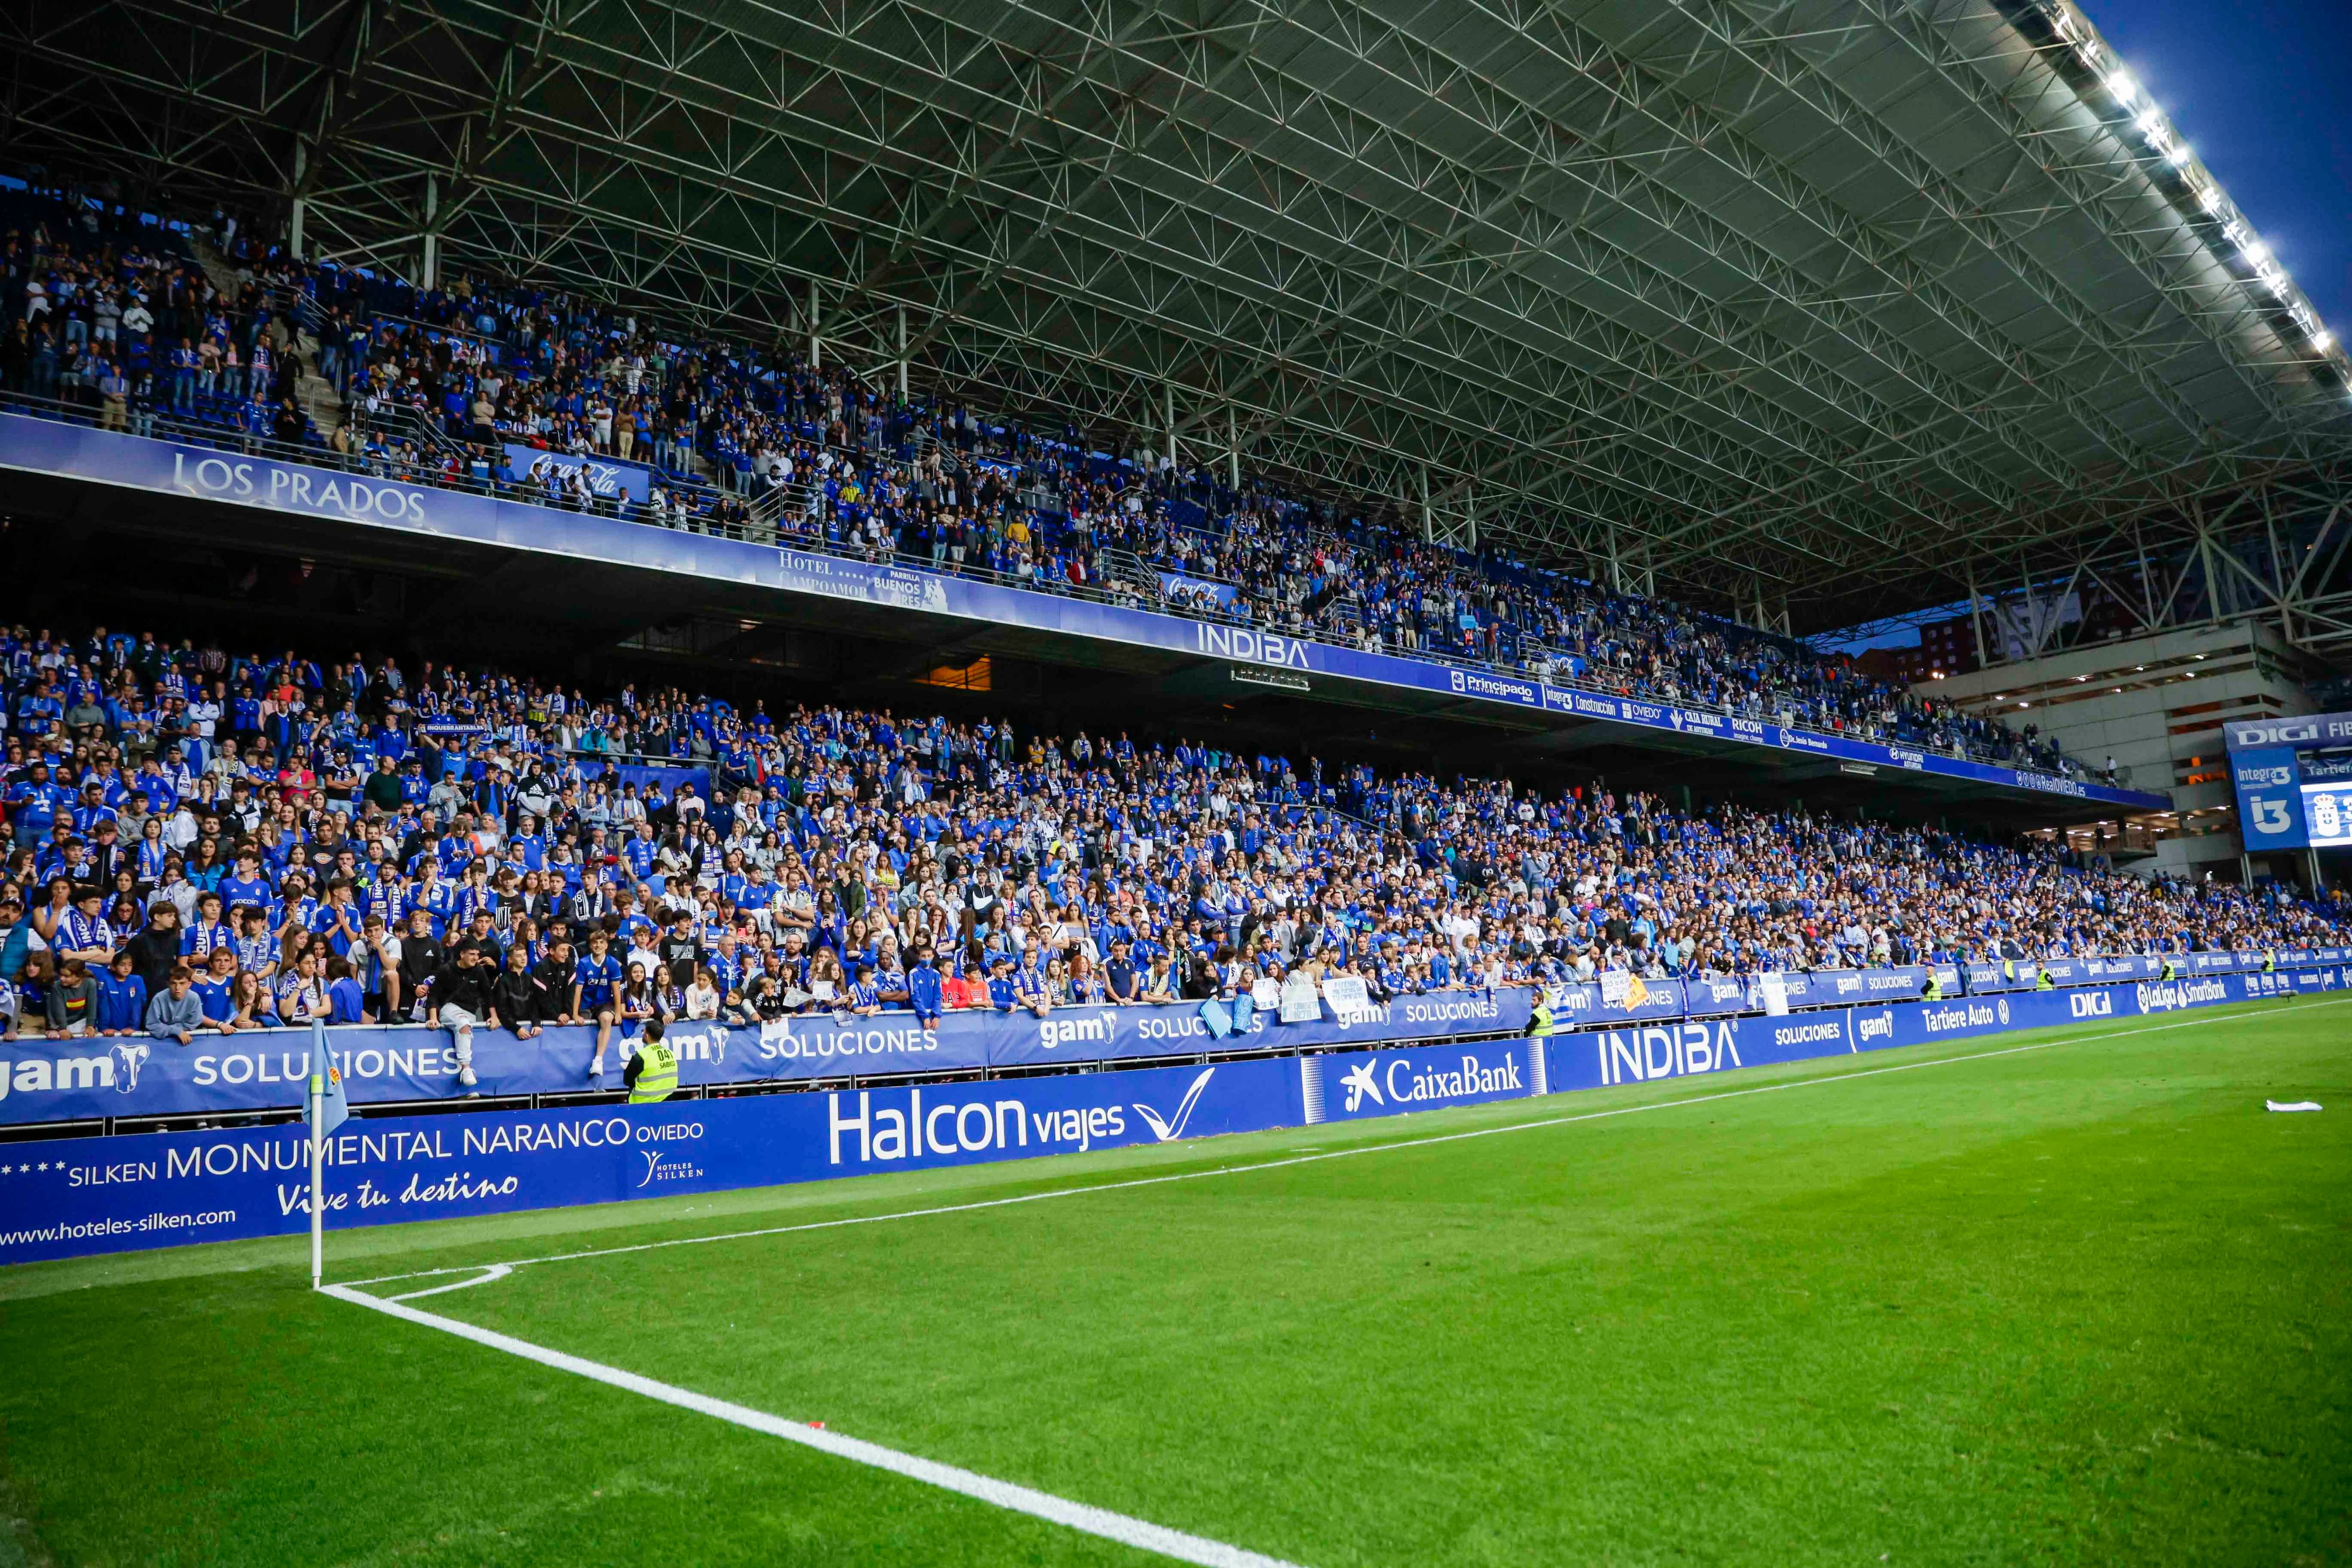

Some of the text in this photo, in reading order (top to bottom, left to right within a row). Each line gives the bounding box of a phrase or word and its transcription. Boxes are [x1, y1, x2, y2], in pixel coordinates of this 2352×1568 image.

[173, 453, 425, 523] LOS PRADOS
[779, 551, 833, 575] HOTEL
[874, 577, 921, 594] BUENOS
[890, 571, 920, 582] PARRILLA
[1467, 676, 1532, 697] Principado
[1469, 685, 1503, 696] PINTURAS
[1576, 695, 1616, 716] Construcción
[1633, 705, 1660, 719] OVIEDO
[1685, 711, 1723, 727] CAJA RURAL
[1732, 719, 1763, 734] RICOH
[2239, 725, 2318, 745] DIGI
[1899, 751, 1924, 763] HYUNDAI
[2309, 765, 2352, 776] Tartier
[230, 898, 259, 906] procoin
[2019, 966, 2034, 981] gam
[1712, 984, 1740, 1003] gam
[1837, 975, 1913, 995] gam SOLUCIONES
[2146, 983, 2177, 1011] LaLiga
[2186, 979, 2227, 1003] SmartBank
[1406, 1001, 1498, 1022] SOLUCIONES
[2070, 991, 2112, 1018] DIGI
[1923, 1004, 1994, 1032] Tartiere Auto
[1041, 1019, 1103, 1048] gam
[1139, 1013, 1263, 1039] SOLUCS
[1775, 1022, 1840, 1046] SOLUCIONES
[1860, 1017, 1887, 1042] gam
[619, 1029, 937, 1070] gm SOLUCIONES
[193, 1047, 463, 1085] SOLUIONES
[1386, 1051, 1522, 1103] CaixaBank
[829, 1089, 1125, 1164] Halcon viajes
[69, 1118, 704, 1187] SILKEN MONUMENTAL NARANCO OVIEDO
[657, 1162, 692, 1172] HOTELES
[657, 1168, 704, 1181] SILKEN
[357, 1179, 389, 1209] tu
[400, 1171, 518, 1204] destino
[0, 1209, 236, 1246] www.hoteles-silken.com
